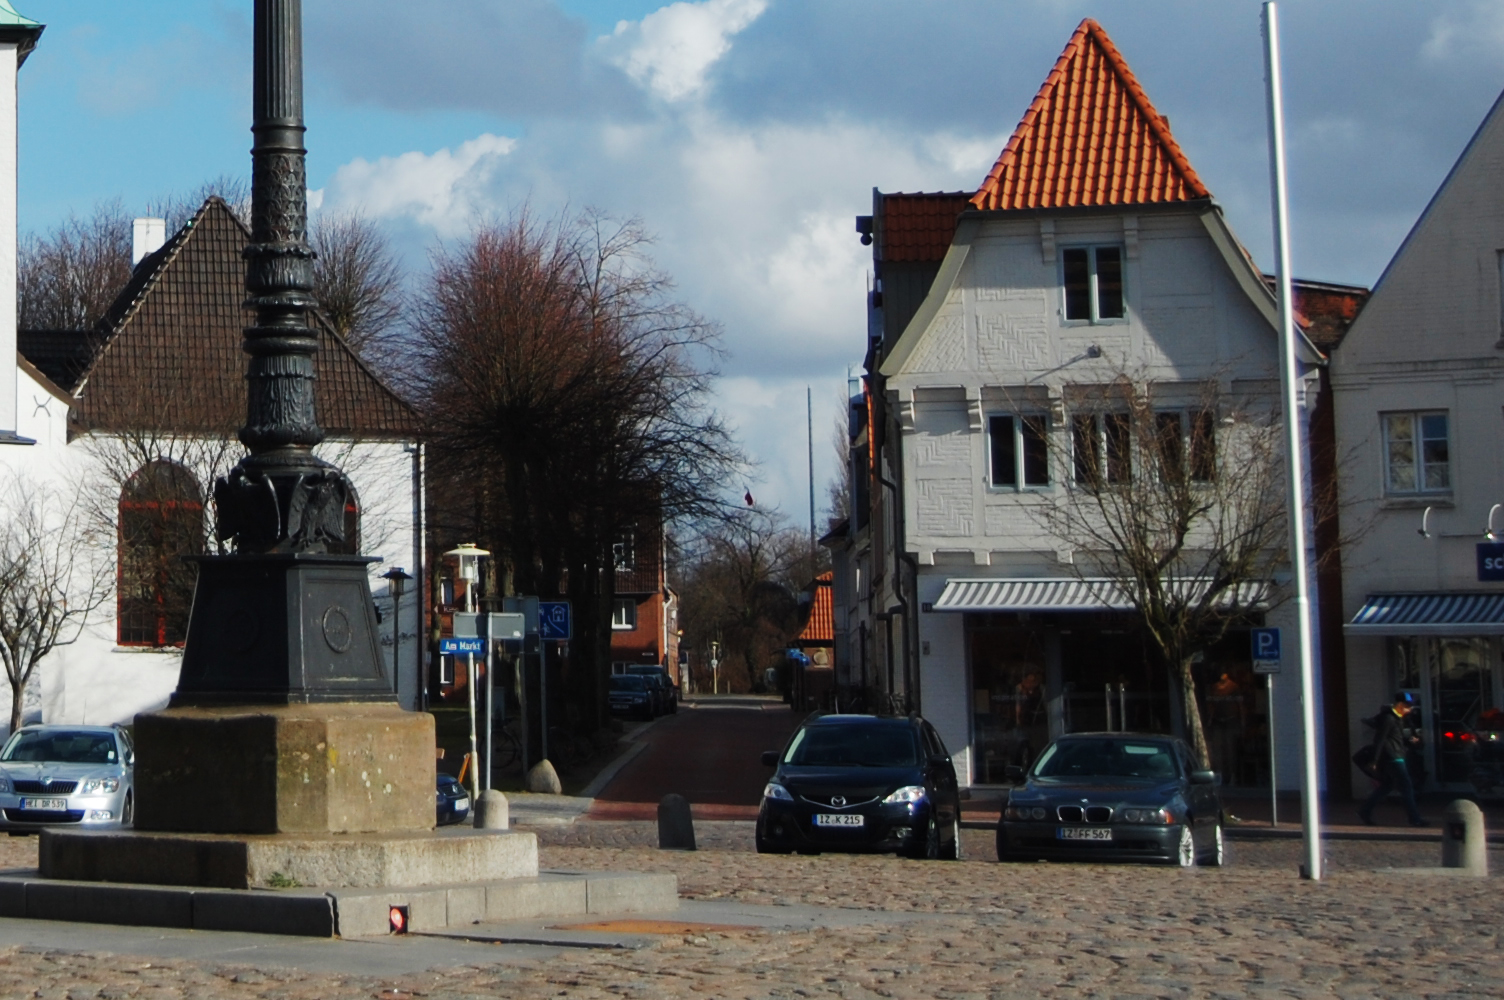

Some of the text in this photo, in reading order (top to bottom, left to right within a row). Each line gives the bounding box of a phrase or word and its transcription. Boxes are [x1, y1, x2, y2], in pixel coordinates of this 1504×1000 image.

[1484, 553, 1504, 570] sc
[445, 640, 481, 651] Am Markt
[1258, 632, 1274, 656] P
[819, 815, 860, 825] IZ K 215
[1062, 829, 1110, 839] IZ FF 567
